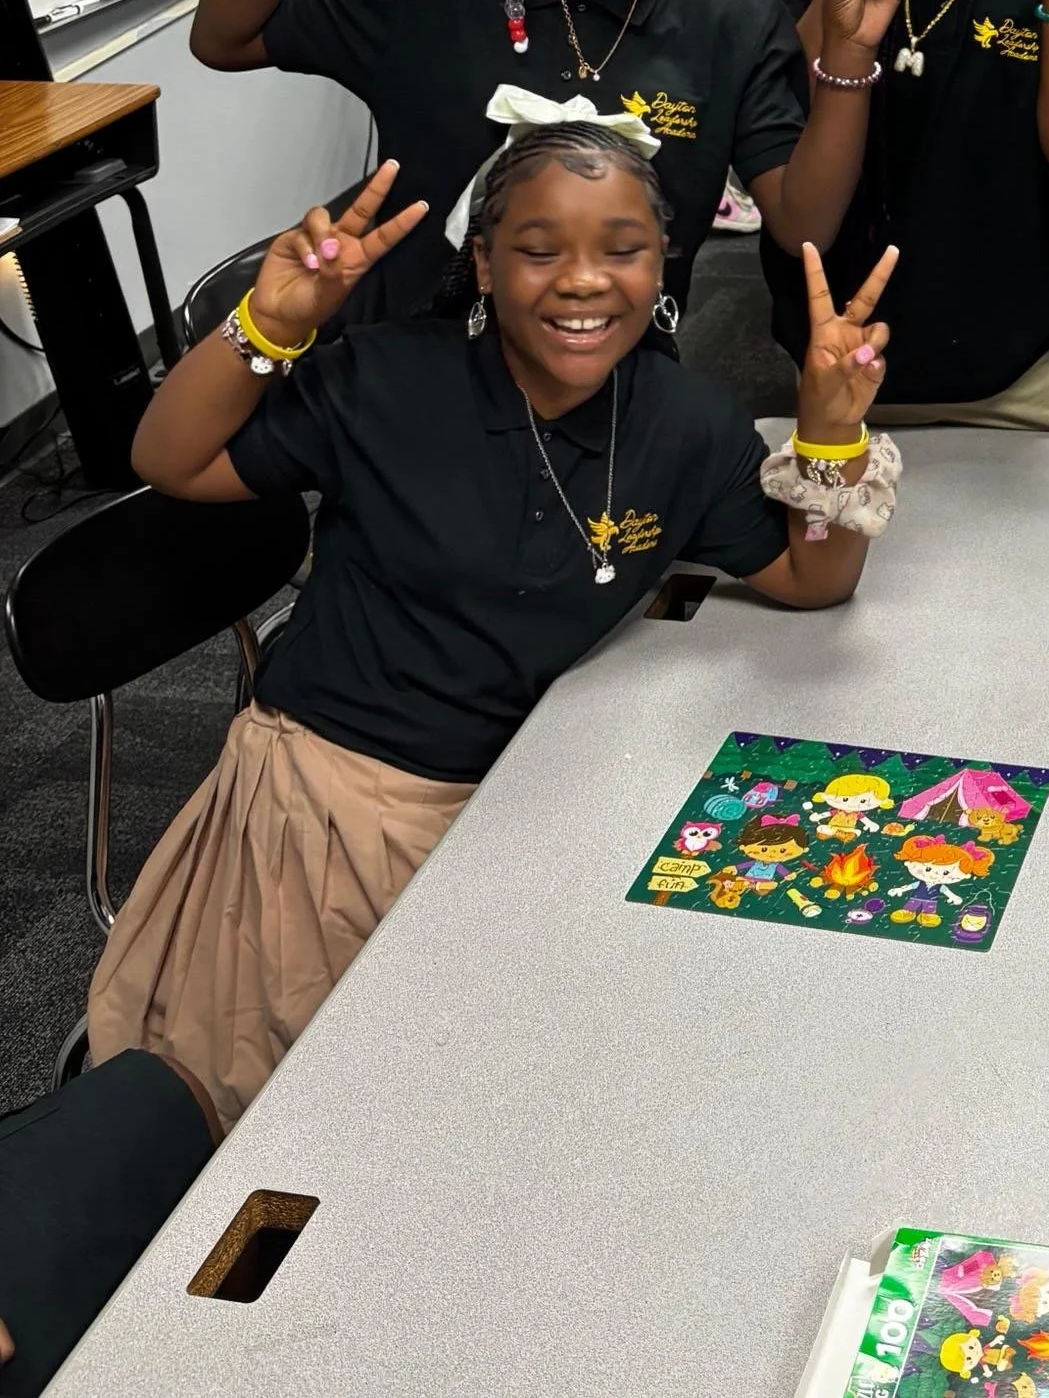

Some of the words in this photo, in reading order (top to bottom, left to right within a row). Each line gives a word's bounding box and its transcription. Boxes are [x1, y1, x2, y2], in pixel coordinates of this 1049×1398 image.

[651, 91, 696, 116] Dayton
[660, 861, 701, 875] camp
[657, 879, 685, 890] fun
[875, 1299, 914, 1356] 100
